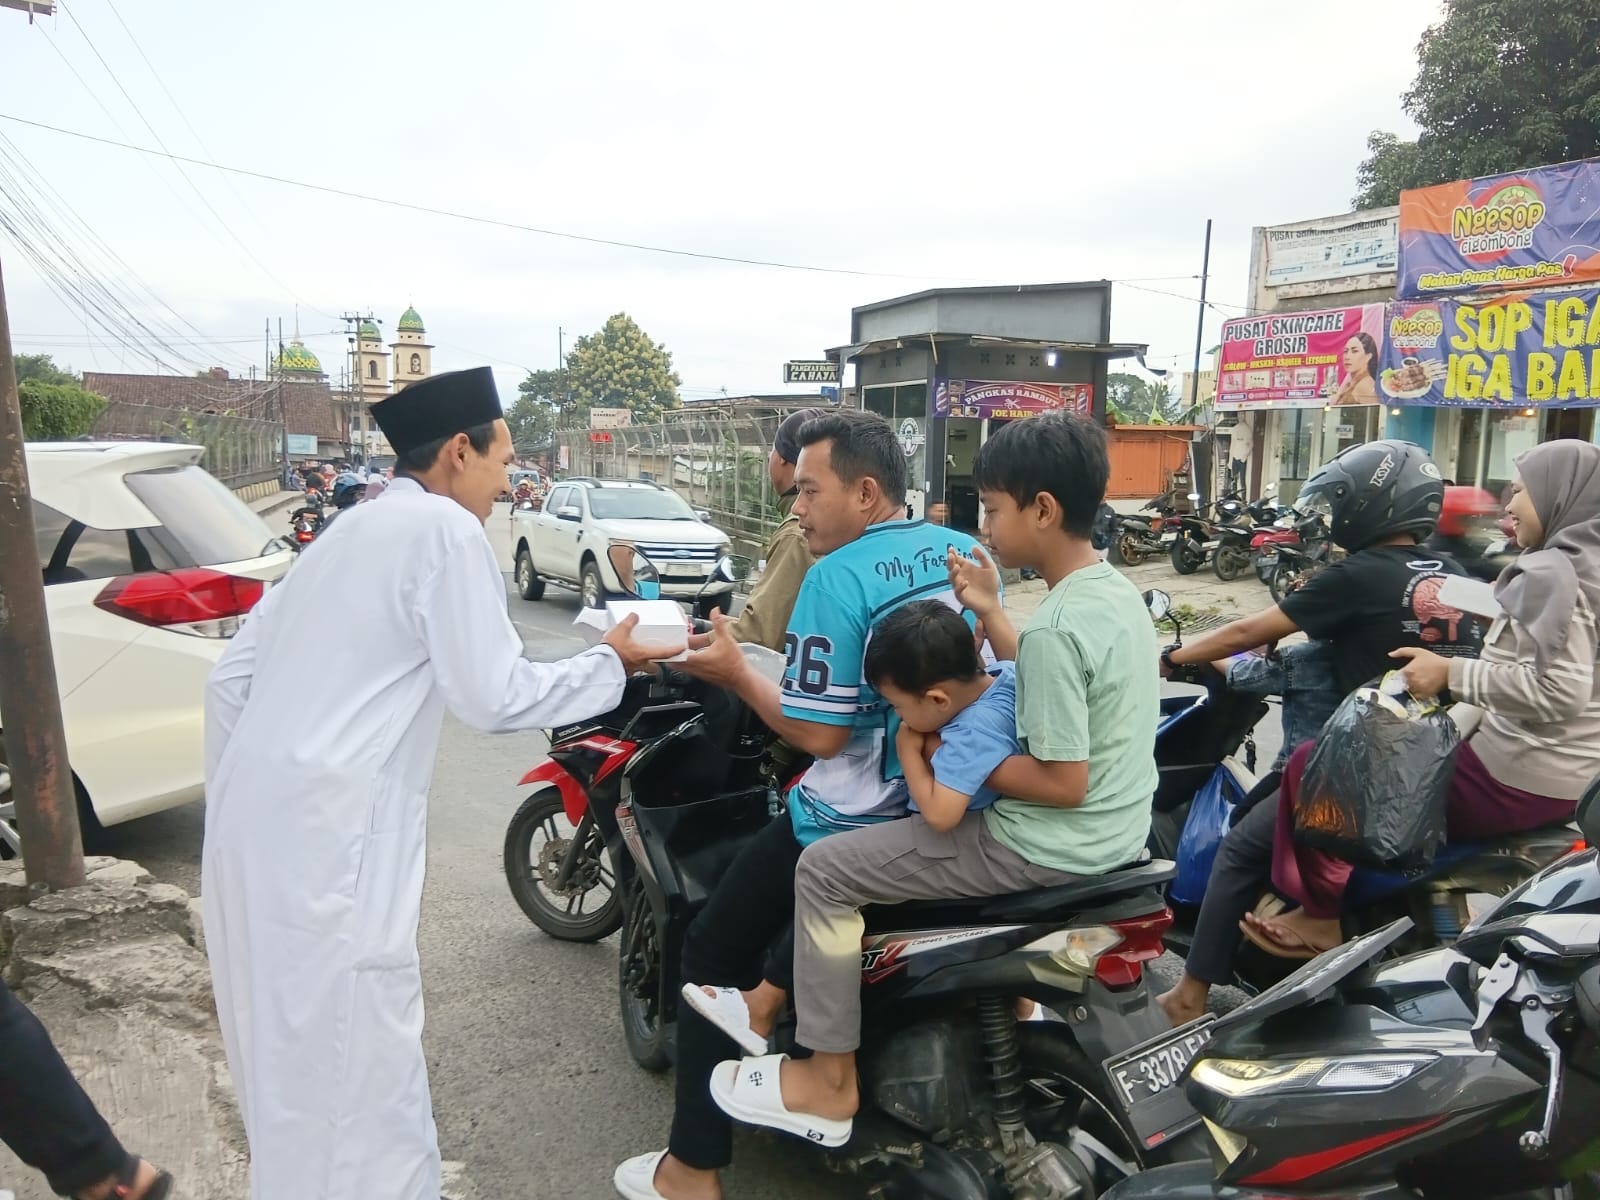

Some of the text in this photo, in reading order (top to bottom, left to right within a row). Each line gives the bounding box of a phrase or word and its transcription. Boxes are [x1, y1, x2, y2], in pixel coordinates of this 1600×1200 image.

[1453, 202, 1544, 239] Ngesop
[1461, 232, 1533, 254] cigombong
[1419, 273, 1461, 288] Makan
[1462, 271, 1495, 284] Puas
[1496, 266, 1535, 282] Harga
[1225, 313, 1344, 341] PUSAT SKINCARE
[1451, 303, 1533, 351] SOP
[1254, 336, 1307, 356] GROSIR
[790, 372, 836, 381] CAHAYA
[1444, 354, 1514, 400] IGA
[964, 388, 1060, 407] PANGKAS RAMBUT
[991, 408, 1007, 418] JOE
[1369, 453, 1394, 487] KYT
[875, 556, 915, 587] My
[1116, 1070, 1134, 1103] F
